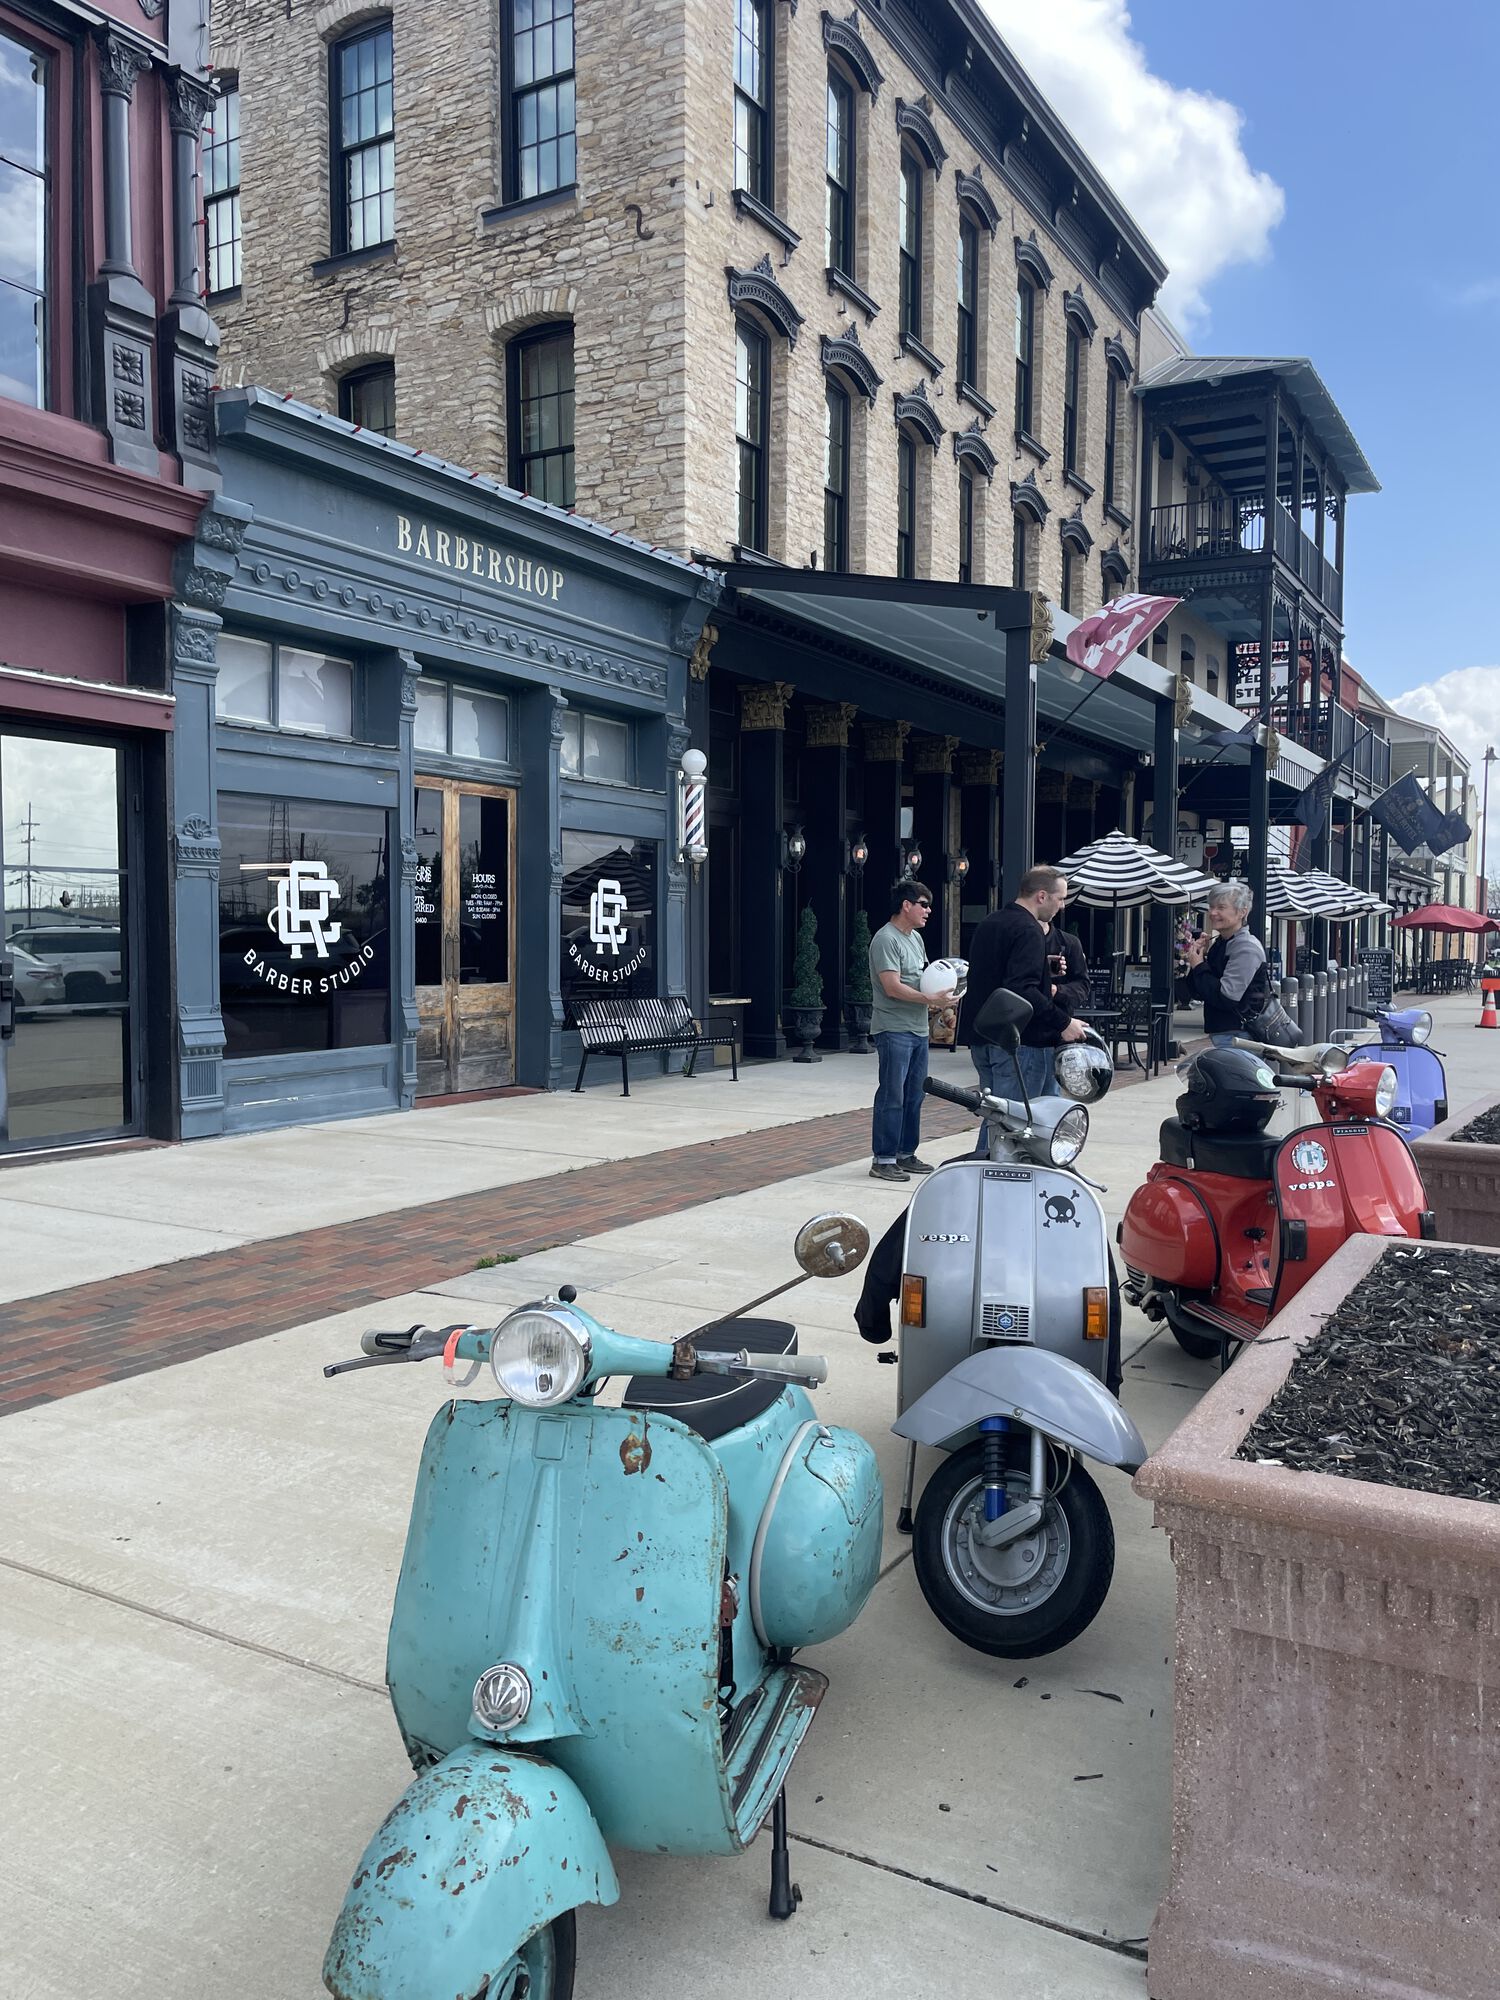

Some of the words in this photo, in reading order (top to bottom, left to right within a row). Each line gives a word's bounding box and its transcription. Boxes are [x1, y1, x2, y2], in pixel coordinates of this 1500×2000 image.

[397, 515, 564, 601] BARBERSHOP
[472, 874, 496, 883] HOURS
[569, 943, 609, 982] BARBER
[612, 947, 646, 982] STUDIO
[243, 948, 312, 994] BARBER
[319, 945, 374, 993] STUDIO
[988, 1170, 1028, 1178] PIAGGIO
[1288, 1179, 1336, 1192] vespa
[918, 1232, 971, 1244] vespa
